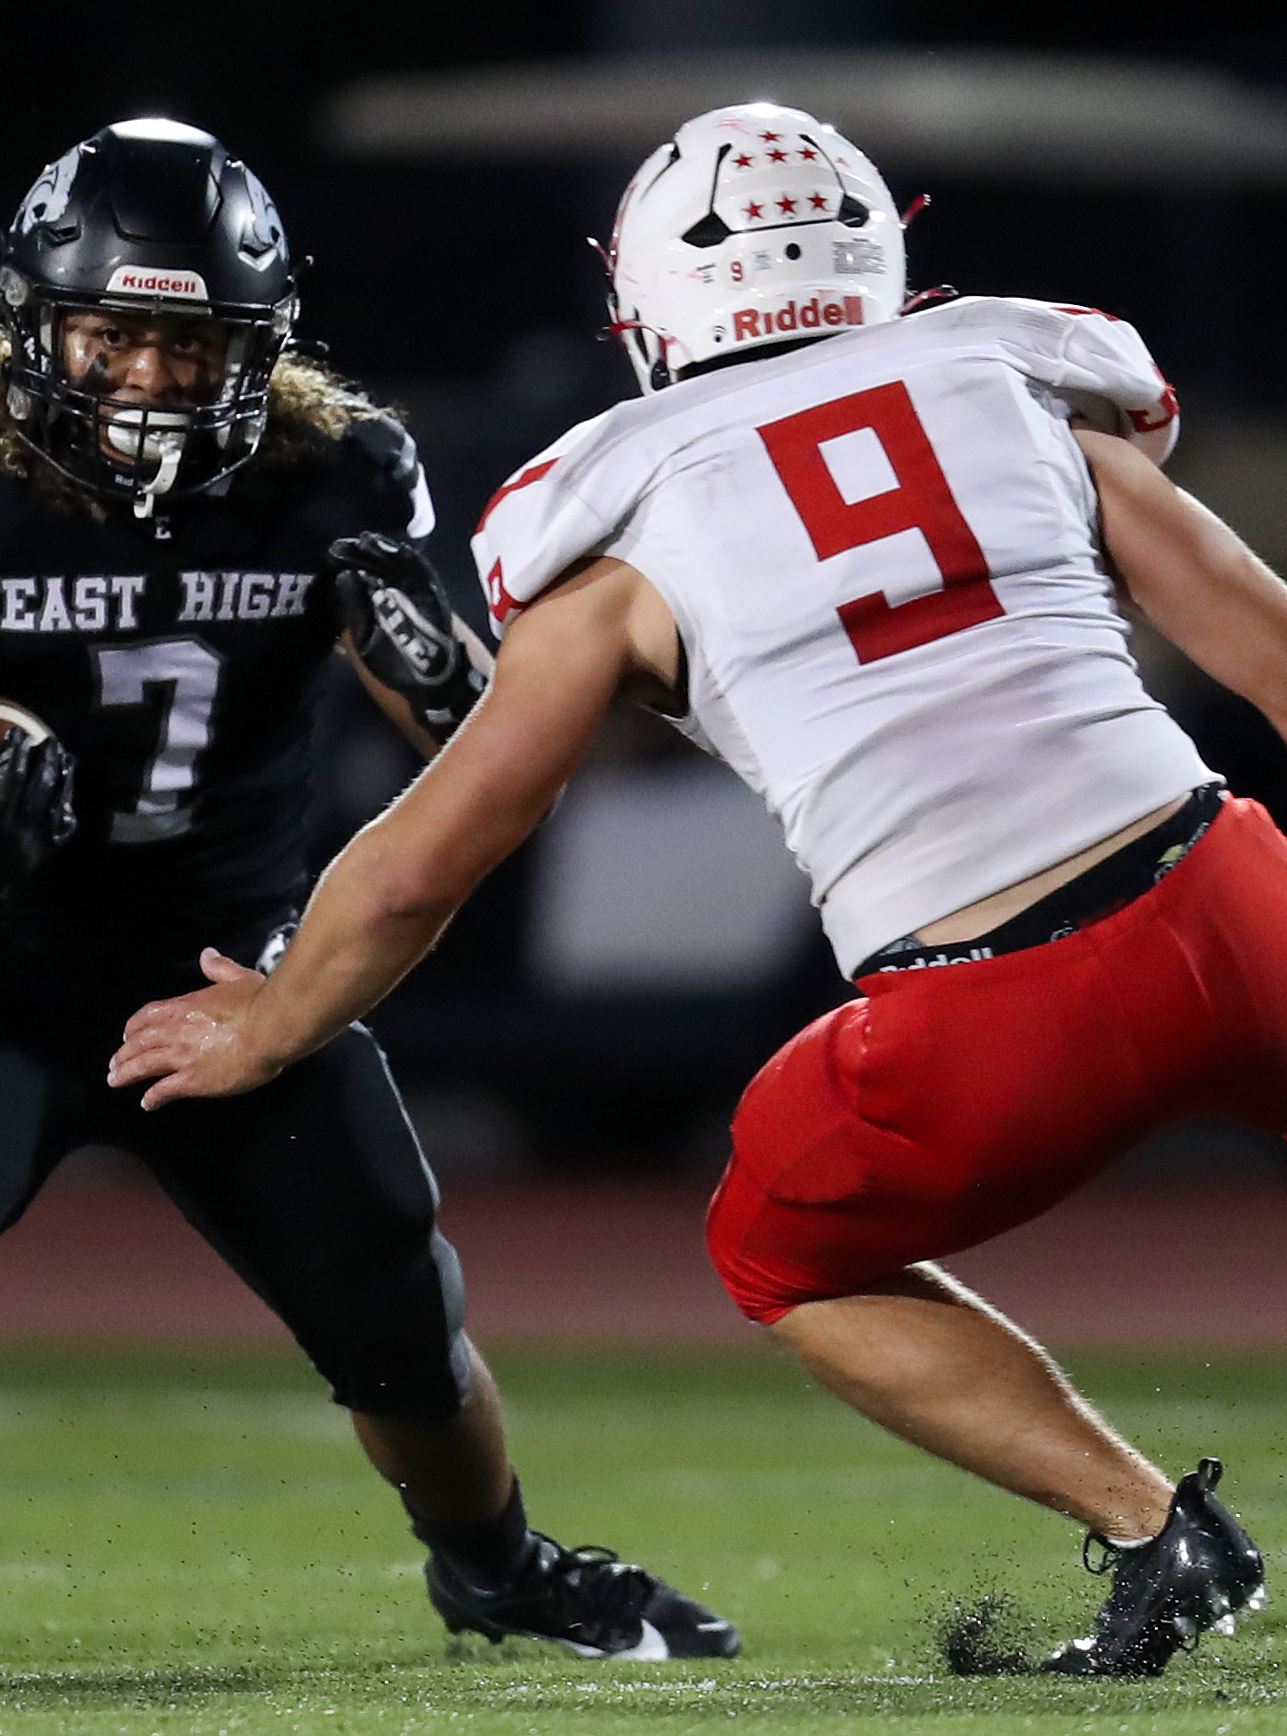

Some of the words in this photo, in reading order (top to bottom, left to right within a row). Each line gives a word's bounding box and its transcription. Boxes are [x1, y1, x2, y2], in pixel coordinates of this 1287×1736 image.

[732, 295, 865, 341] Riddell
[754, 379, 1007, 666] 9
[0, 574, 147, 632] EAST
[177, 569, 316, 622] HIGH
[94, 638, 221, 843] 7
